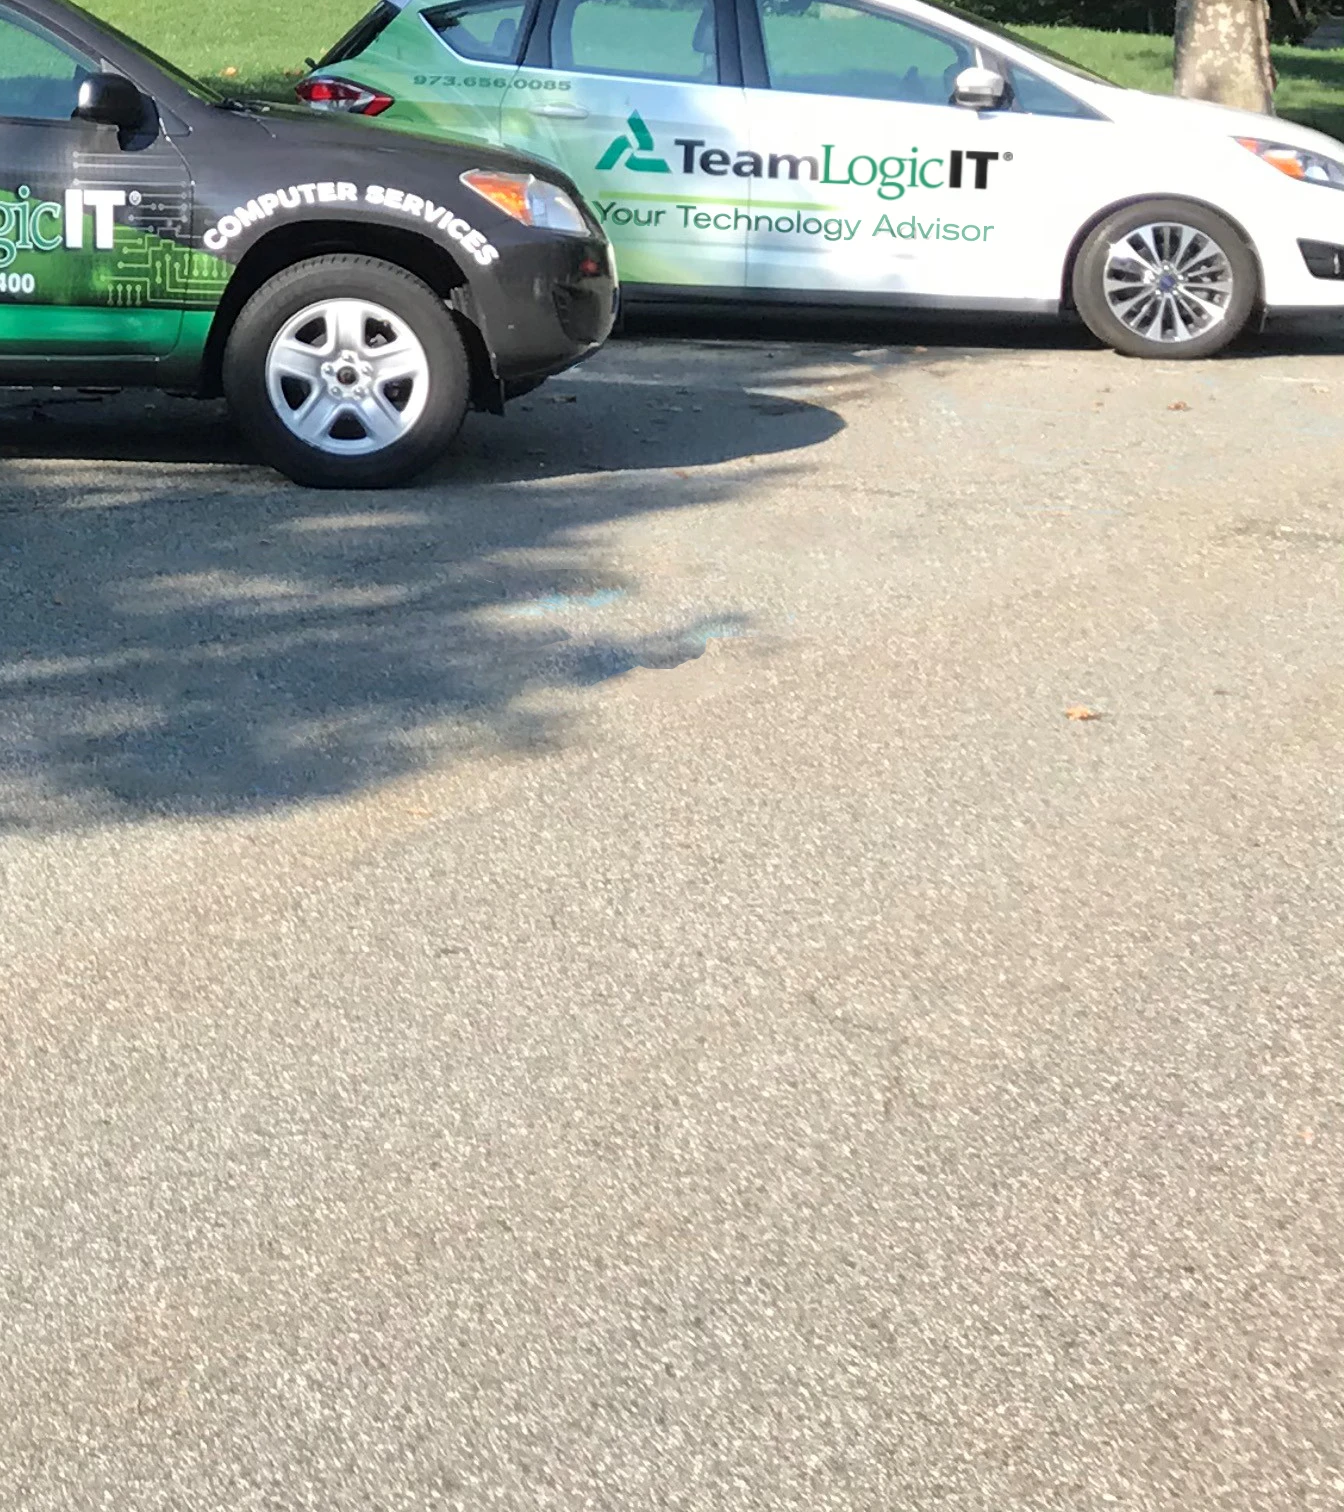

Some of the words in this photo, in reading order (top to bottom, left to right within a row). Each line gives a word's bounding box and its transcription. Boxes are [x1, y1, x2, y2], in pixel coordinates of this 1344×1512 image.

[413, 75, 572, 91] 973.656.0085
[202, 182, 359, 250] COMPUTER
[365, 184, 501, 266] SERVICES
[592, 201, 667, 227] Your
[676, 203, 862, 241] Technology
[872, 213, 995, 243] Advisor
